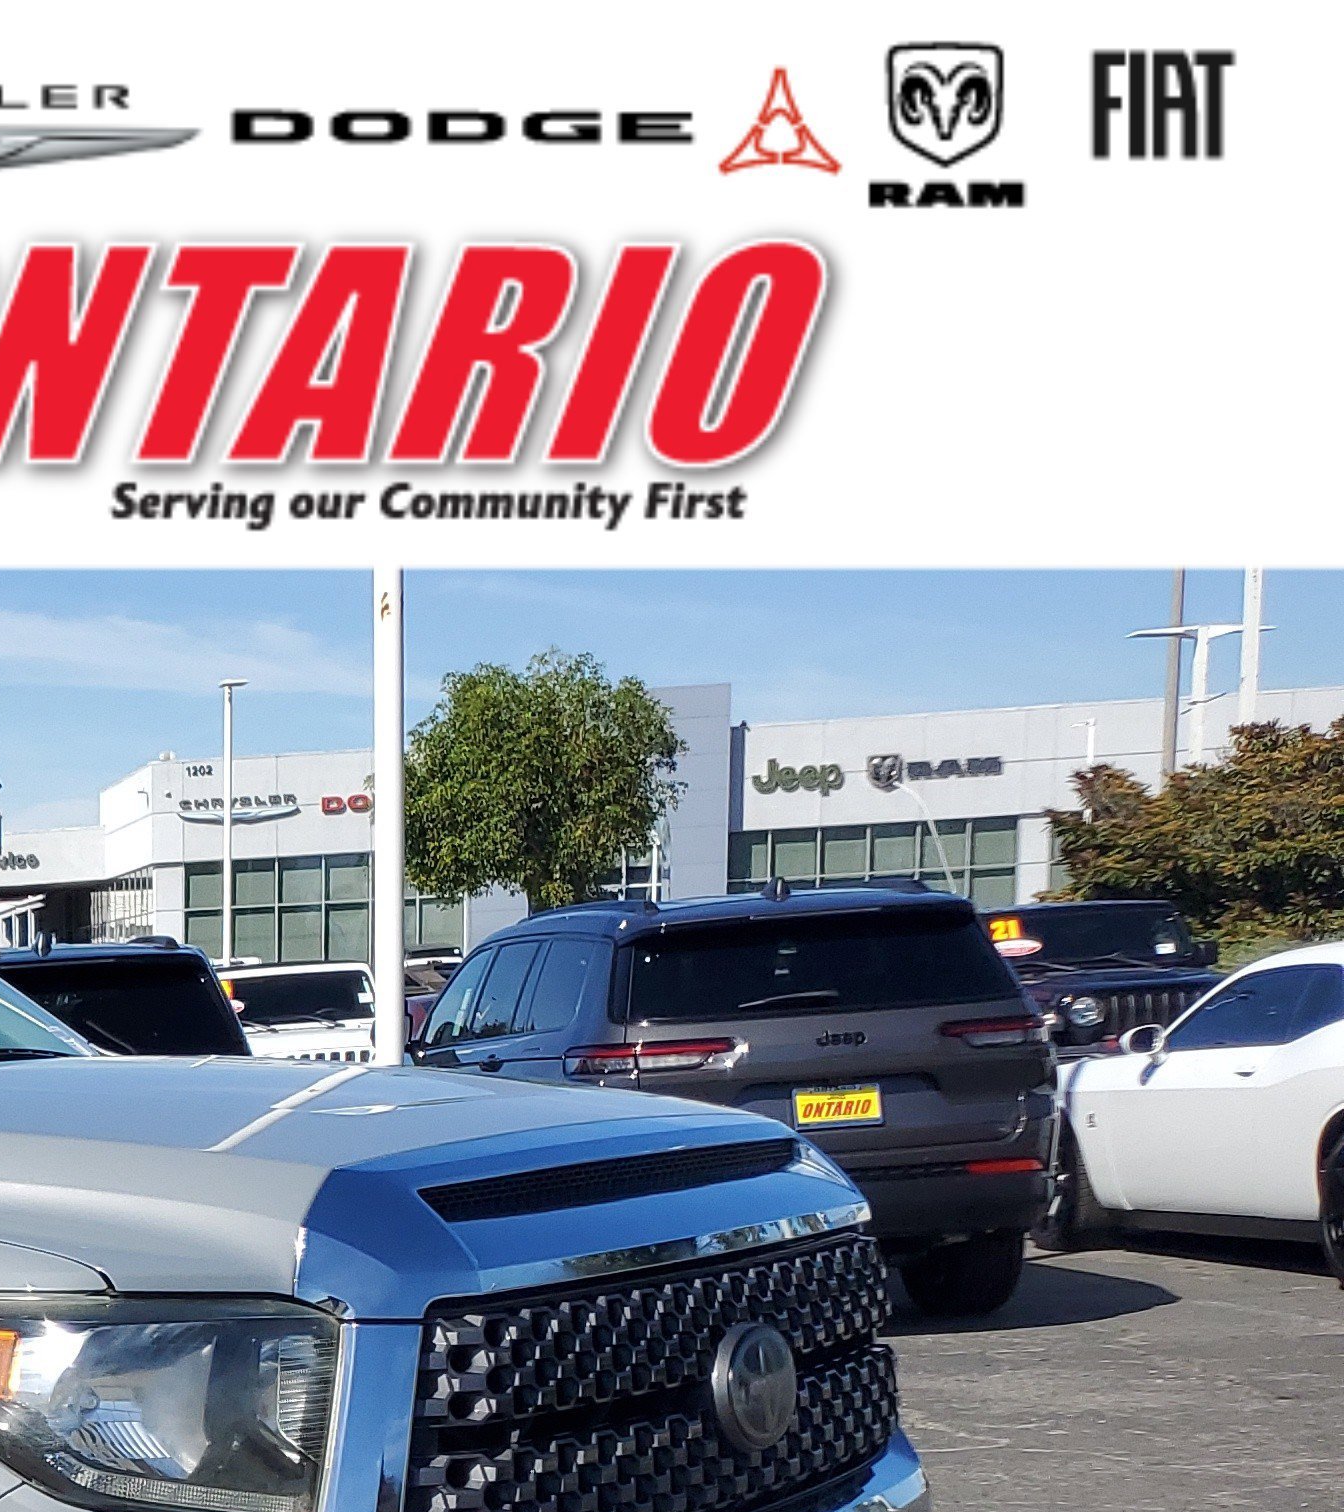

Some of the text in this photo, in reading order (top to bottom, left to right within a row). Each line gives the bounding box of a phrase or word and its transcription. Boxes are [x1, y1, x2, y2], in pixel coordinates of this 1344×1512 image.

[185, 764, 214, 778] 1202
[751, 757, 844, 797] Jeep
[906, 756, 1003, 781] RAM
[988, 917, 1022, 941] 21
[815, 1030, 868, 1048] Jeep
[801, 1098, 872, 1119] ONTARIO
